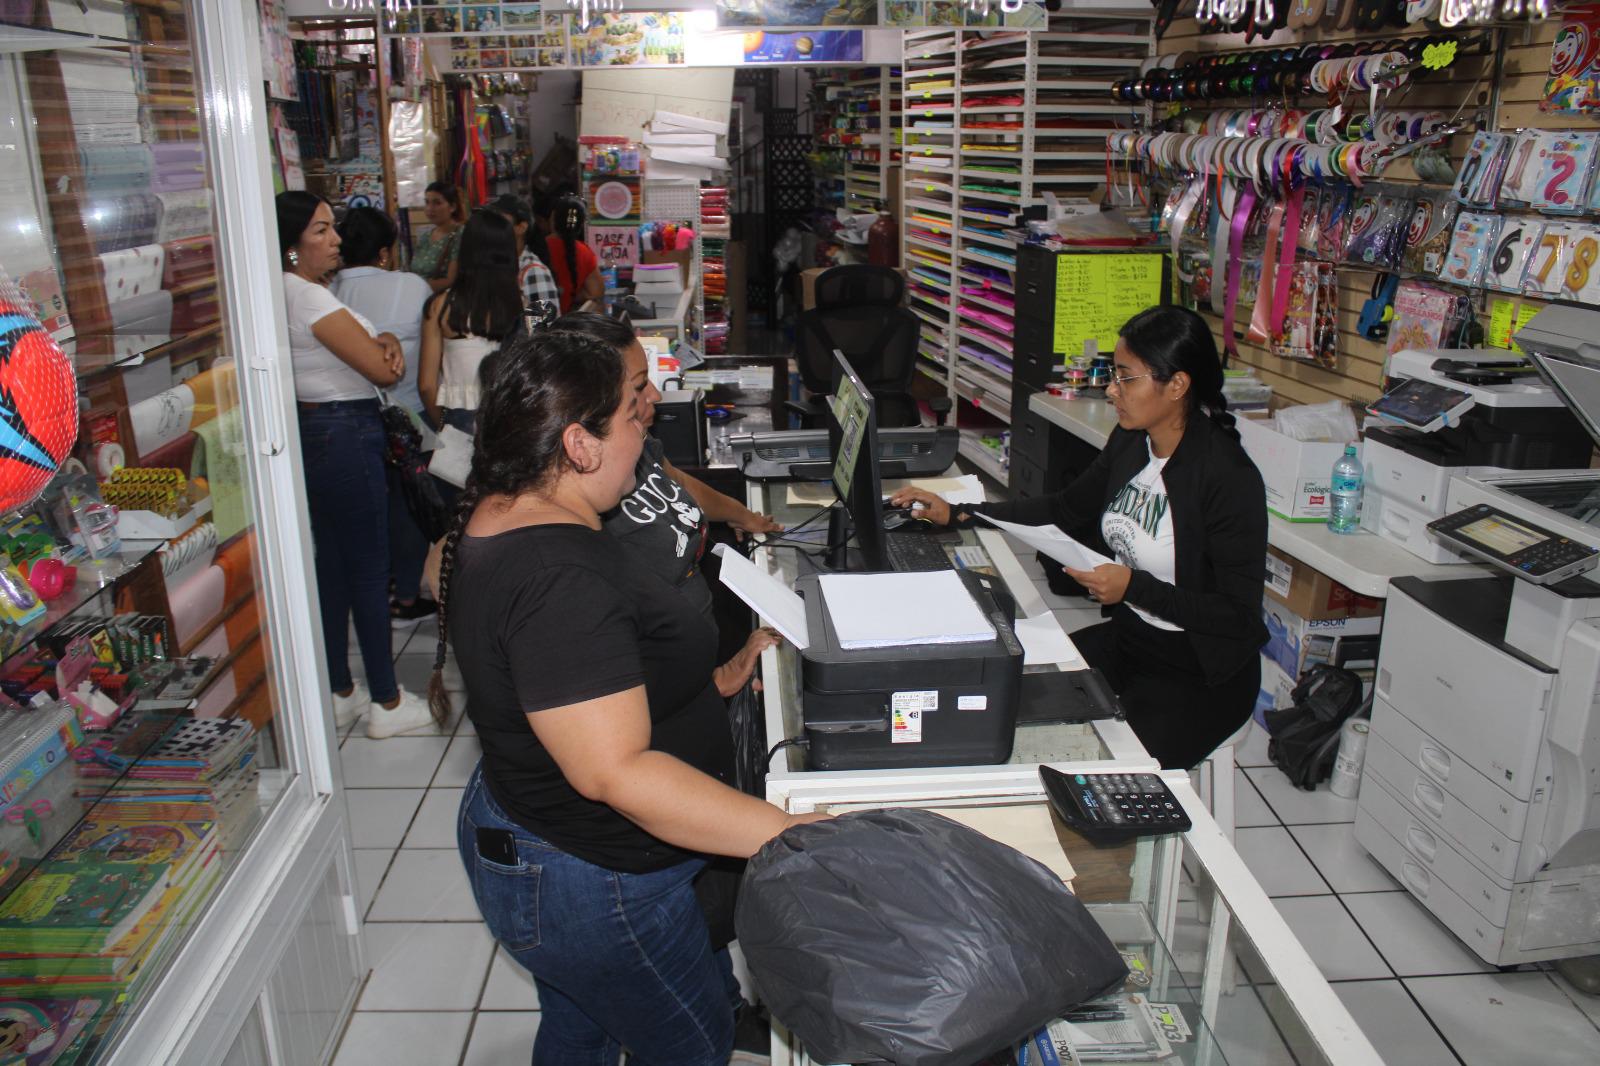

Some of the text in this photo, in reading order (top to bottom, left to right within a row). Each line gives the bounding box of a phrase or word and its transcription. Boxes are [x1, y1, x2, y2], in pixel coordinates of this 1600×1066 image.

[1544, 155, 1577, 202] 2
[594, 233, 634, 246] PASE A
[1492, 228, 1522, 274] 6
[1537, 234, 1568, 283] 7
[1565, 236, 1599, 291] 8
[1303, 485, 1331, 495] Ecológic
[1308, 618, 1346, 627] EPSON
[1054, 1039, 1073, 1062] P907
